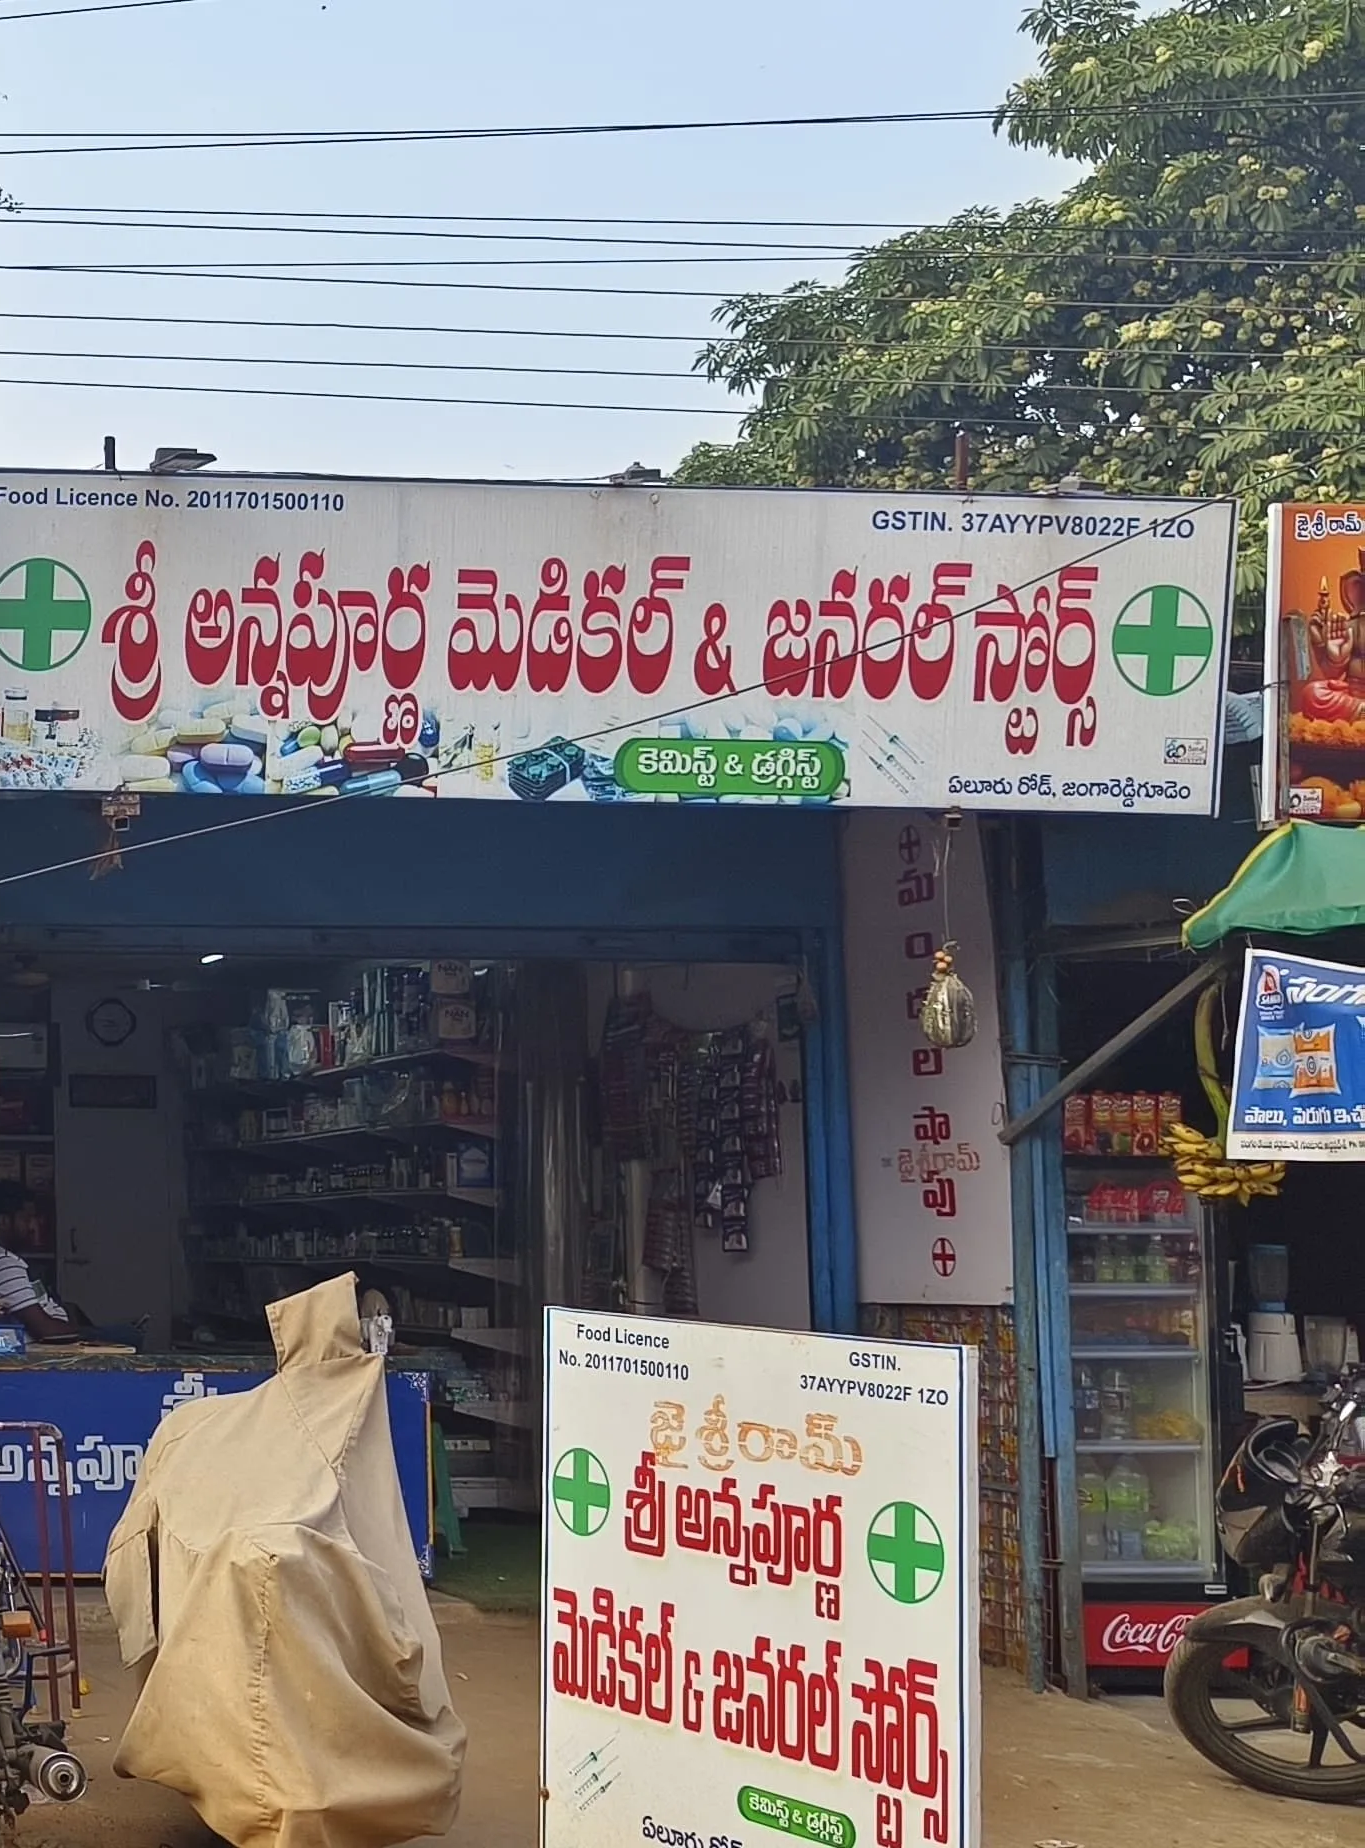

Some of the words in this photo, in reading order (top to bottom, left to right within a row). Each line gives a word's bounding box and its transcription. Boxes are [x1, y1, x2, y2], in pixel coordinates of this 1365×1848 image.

[55, 488, 138, 509] Licence
[145, 490, 180, 509] No.
[186, 490, 345, 513] 2011701500110
[871, 509, 953, 533] GSTIN.
[961, 511, 1140, 537] 37AYYPV8022F
[101, 539, 162, 722] శ్రీ
[184, 547, 431, 746] అన్నపూర్ణ
[447, 556, 690, 694] మెడికల్
[694, 602, 737, 696] &
[763, 563, 973, 700] జనరల్
[973, 564, 1099, 756] స్టోర్స్
[637, 746, 718, 788] కెమిస్ట్
[723, 754, 744, 776] &
[948, 775, 1013, 796] ఏలూరు
[576, 1323, 612, 1344] Food
[615, 1327, 670, 1350] Licence
[559, 1350, 581, 1368] No.
[584, 1353, 689, 1381] 2011701500110
[849, 1351, 901, 1372] GSTIN.
[800, 1374, 912, 1402] 37AYYPV8022F
[624, 1451, 666, 1557] శ్రీ
[553, 1587, 676, 1725] మెడికల్
[712, 1635, 842, 1772] జనరల్
[792, 1809, 803, 1823] &
